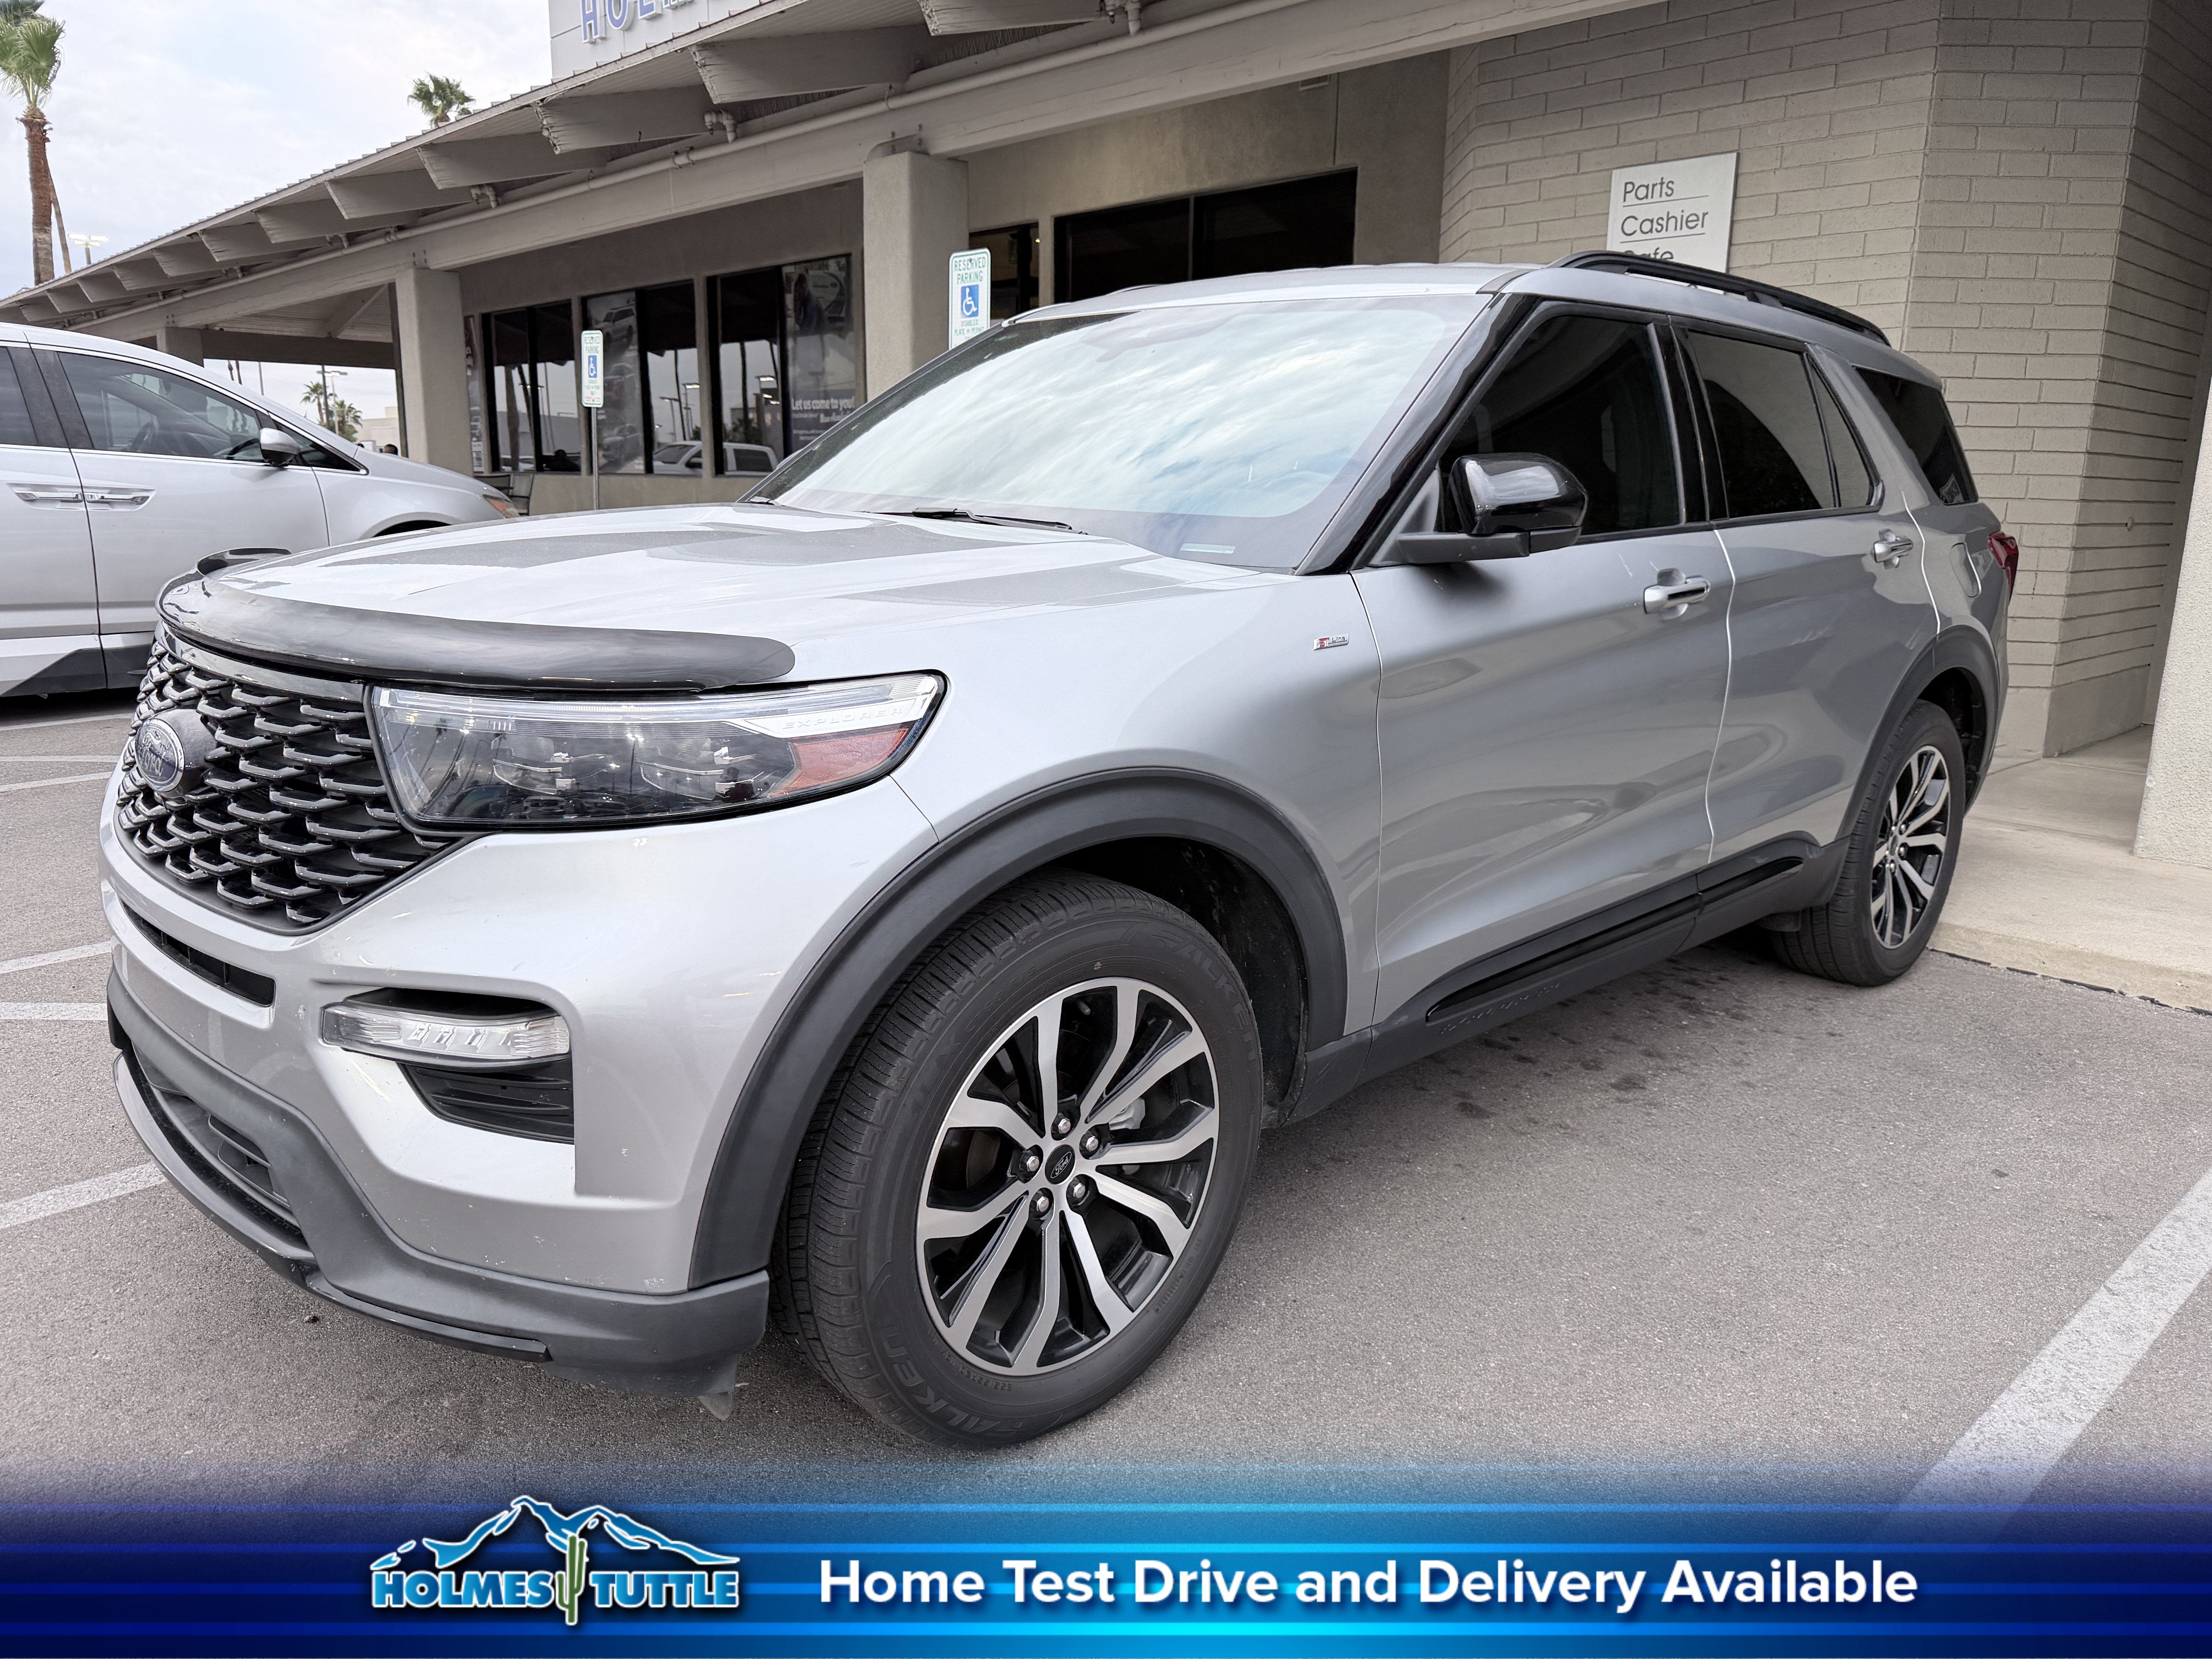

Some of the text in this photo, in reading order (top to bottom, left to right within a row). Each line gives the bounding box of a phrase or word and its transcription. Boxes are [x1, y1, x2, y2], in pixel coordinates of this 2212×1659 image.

[1623, 177, 1674, 202] Parts
[1621, 209, 1709, 236] Cashier
[954, 256, 986, 271] RESERVED
[957, 271, 983, 284] PARKING
[792, 397, 803, 410] Let
[803, 400, 811, 410] us
[812, 400, 830, 409] come
[830, 397, 839, 409] to
[782, 707, 903, 729] EXPLORER
[1055, 1156, 1069, 1175] Ford
